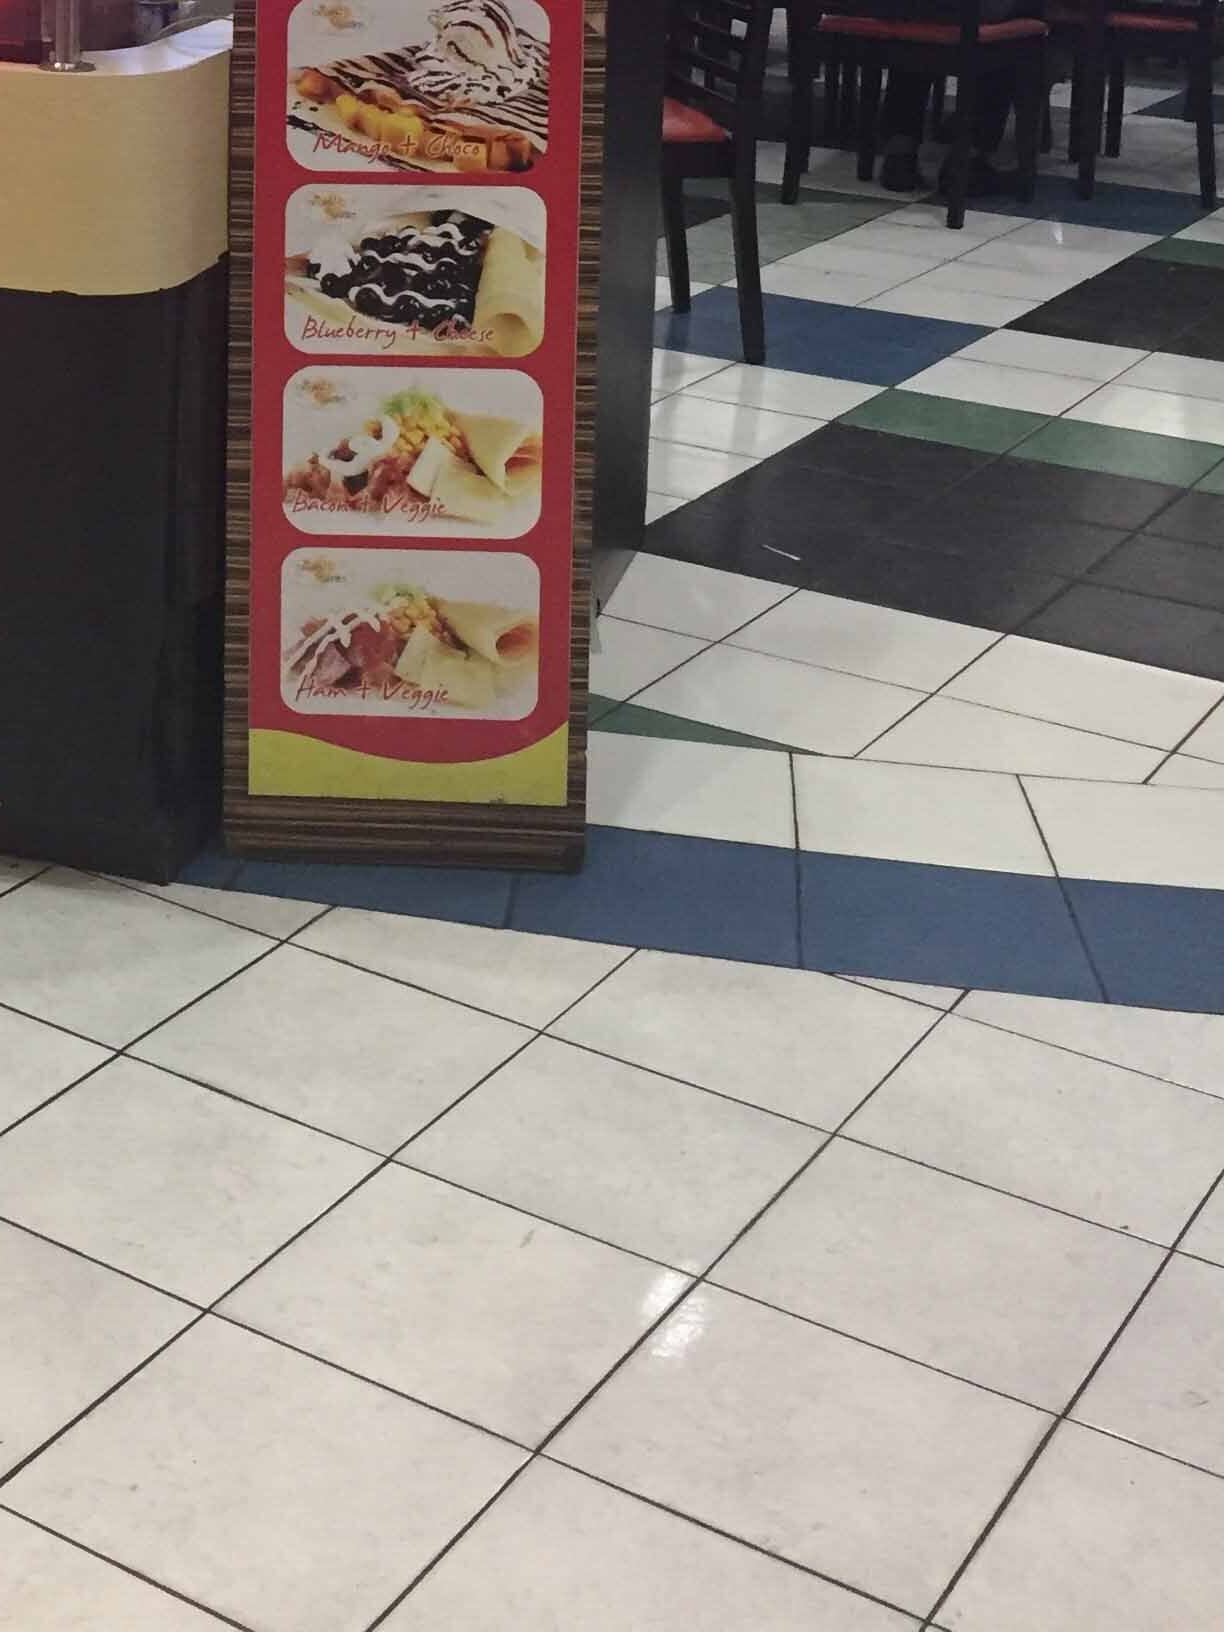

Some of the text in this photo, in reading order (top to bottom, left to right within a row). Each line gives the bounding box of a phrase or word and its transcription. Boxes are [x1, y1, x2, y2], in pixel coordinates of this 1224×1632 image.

[425, 135, 482, 158] Choco
[300, 315, 397, 349] Blueberry
[381, 495, 447, 522] Veggie
[294, 677, 349, 703] Ham
[381, 681, 450, 710] Veggie
